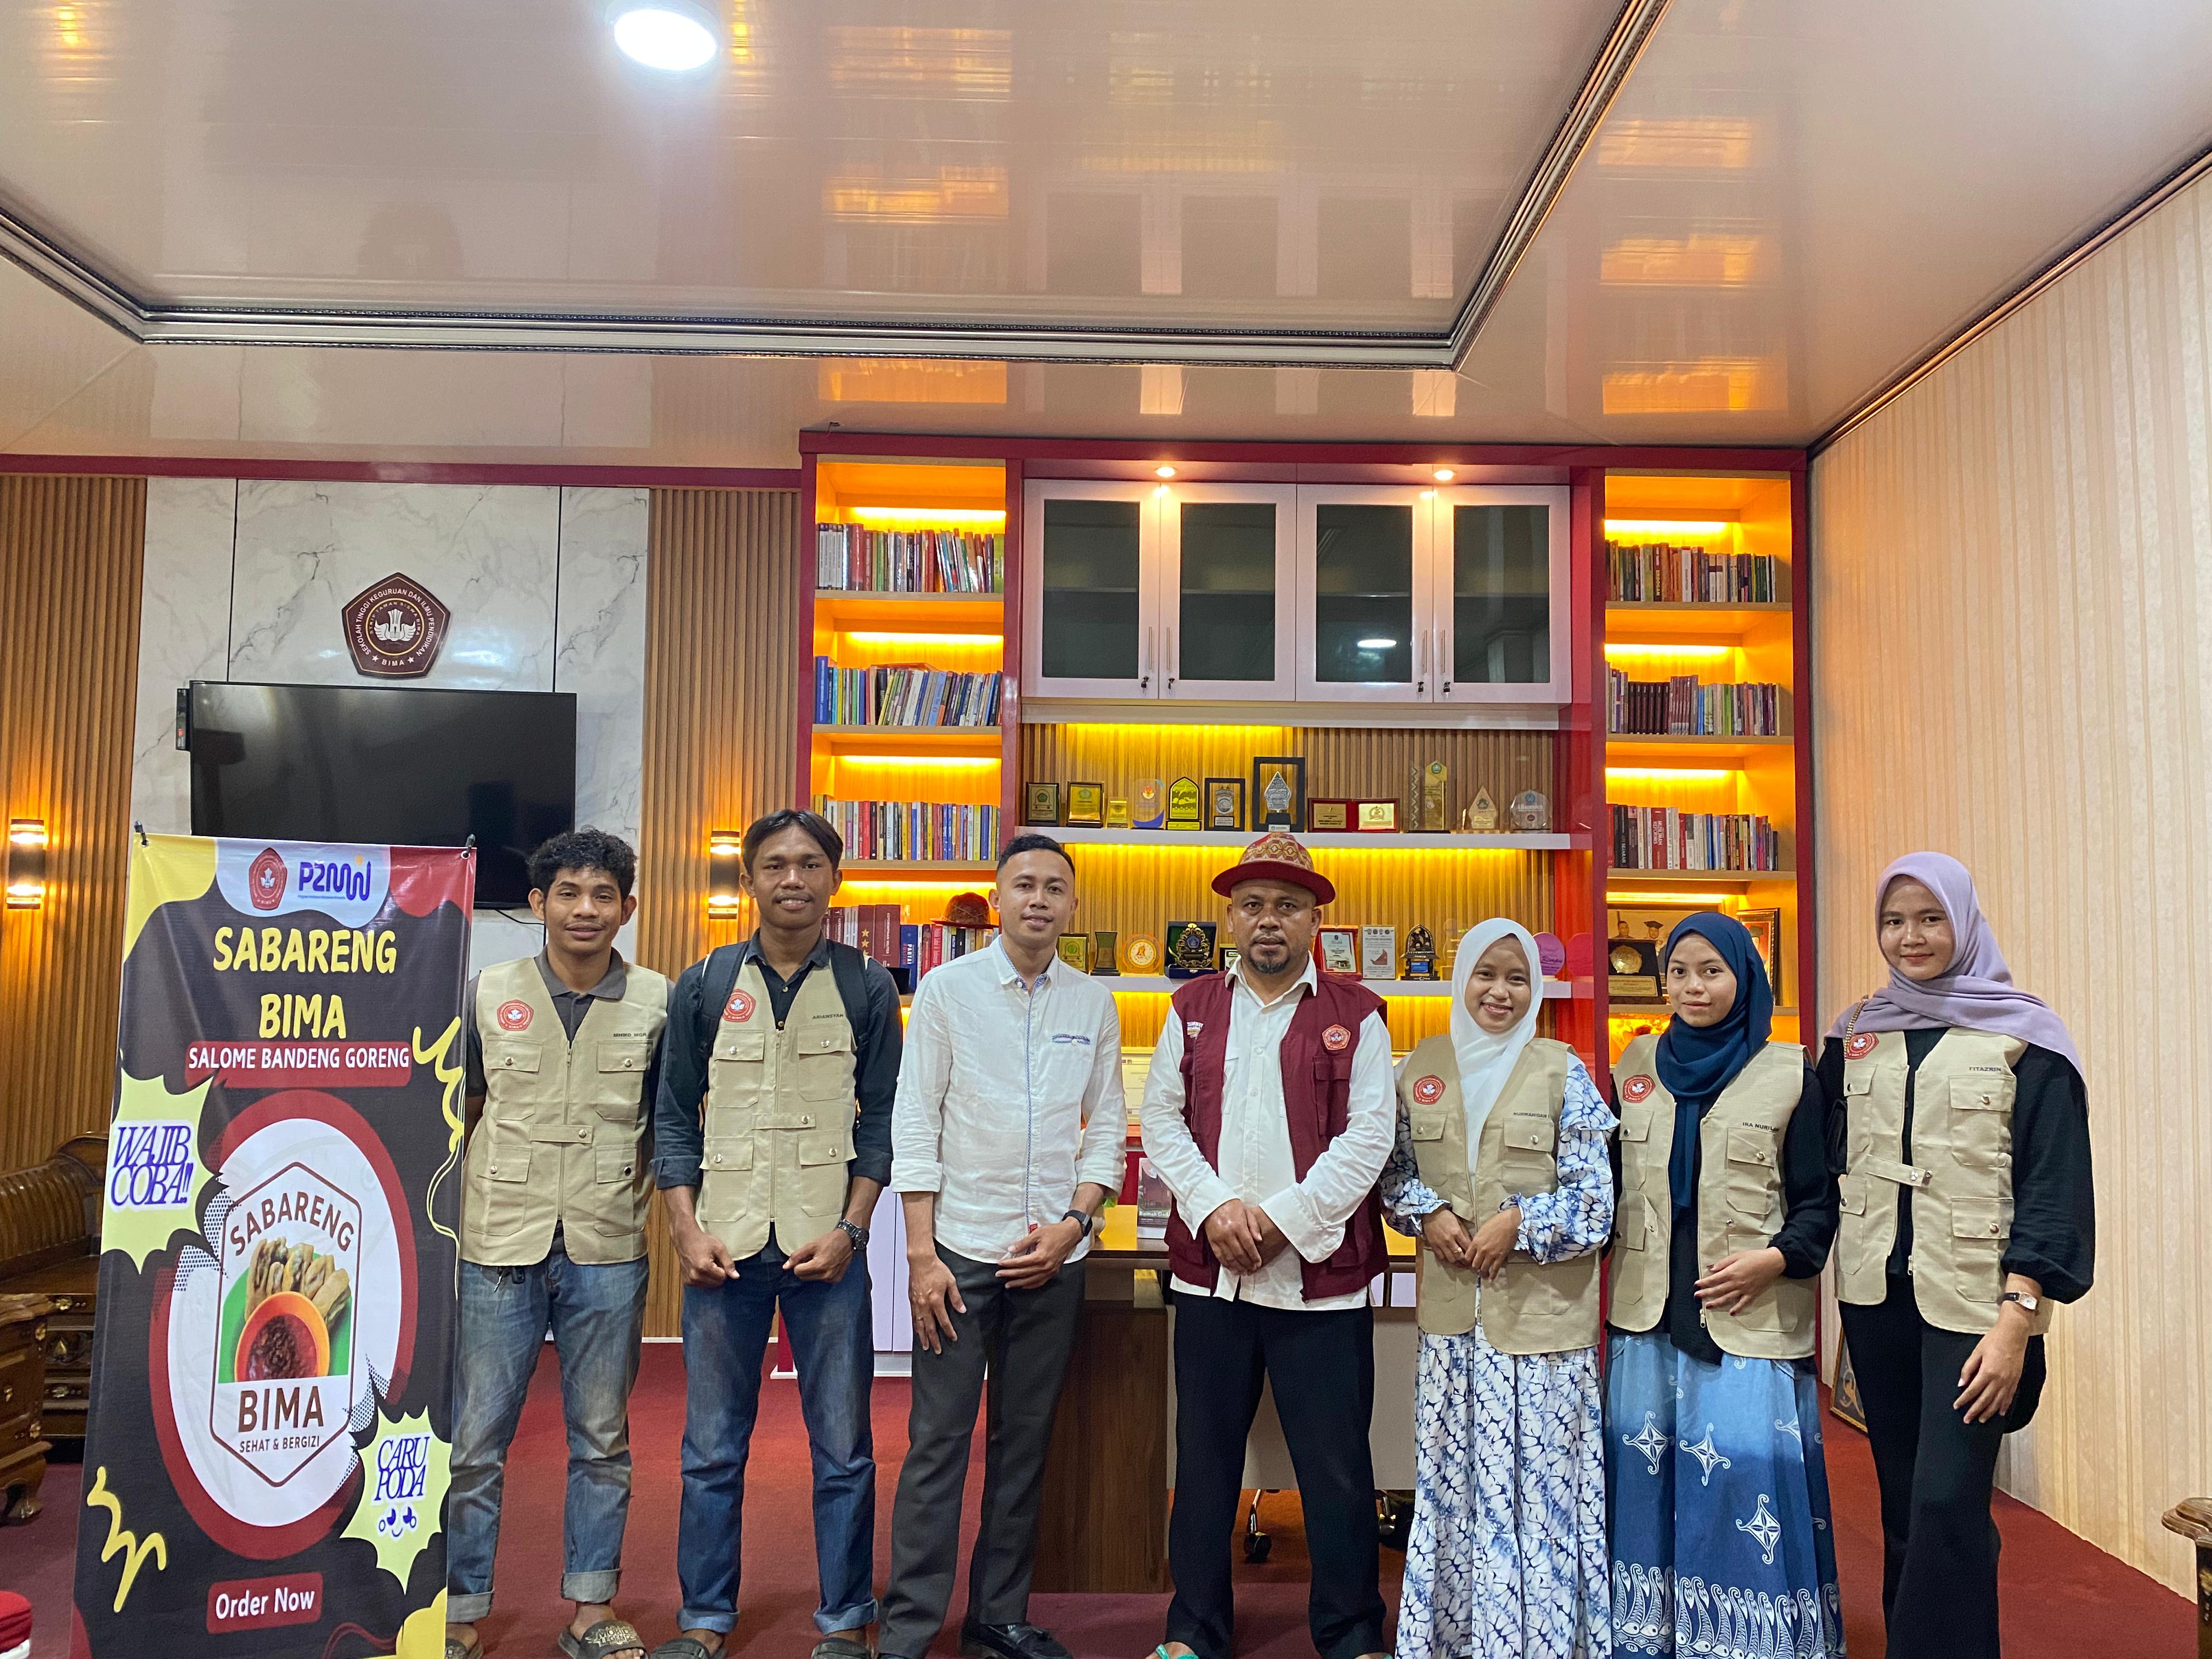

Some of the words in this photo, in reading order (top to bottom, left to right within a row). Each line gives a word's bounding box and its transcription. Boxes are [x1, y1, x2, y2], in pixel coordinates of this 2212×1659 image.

[356, 601, 371, 623] TINGGI
[369, 588, 407, 603] KEGURUAN
[408, 591, 422, 603] DAN
[420, 601, 432, 617] ILMU
[356, 620, 371, 655] SEKOLAH
[415, 617, 435, 657] PENDIDIKAN
[213, 926, 397, 974] SABARENG
[258, 994, 346, 1039] BIMA
[188, 1047, 256, 1069] SALOME
[261, 1047, 340, 1069] BANDENG
[345, 1047, 409, 1068] GORENG
[113, 1126, 191, 1168] WAJIB
[230, 1191, 354, 1256] SABARENG
[238, 1386, 324, 1433] BIMA
[240, 1438, 270, 1453] SEHAT
[274, 1438, 279, 1450] &
[283, 1435, 320, 1450] BERGIZI
[378, 1436, 430, 1469] CARU
[374, 1464, 426, 1500] PODA
[216, 1590, 268, 1620] Order
[274, 1587, 314, 1613] Now
